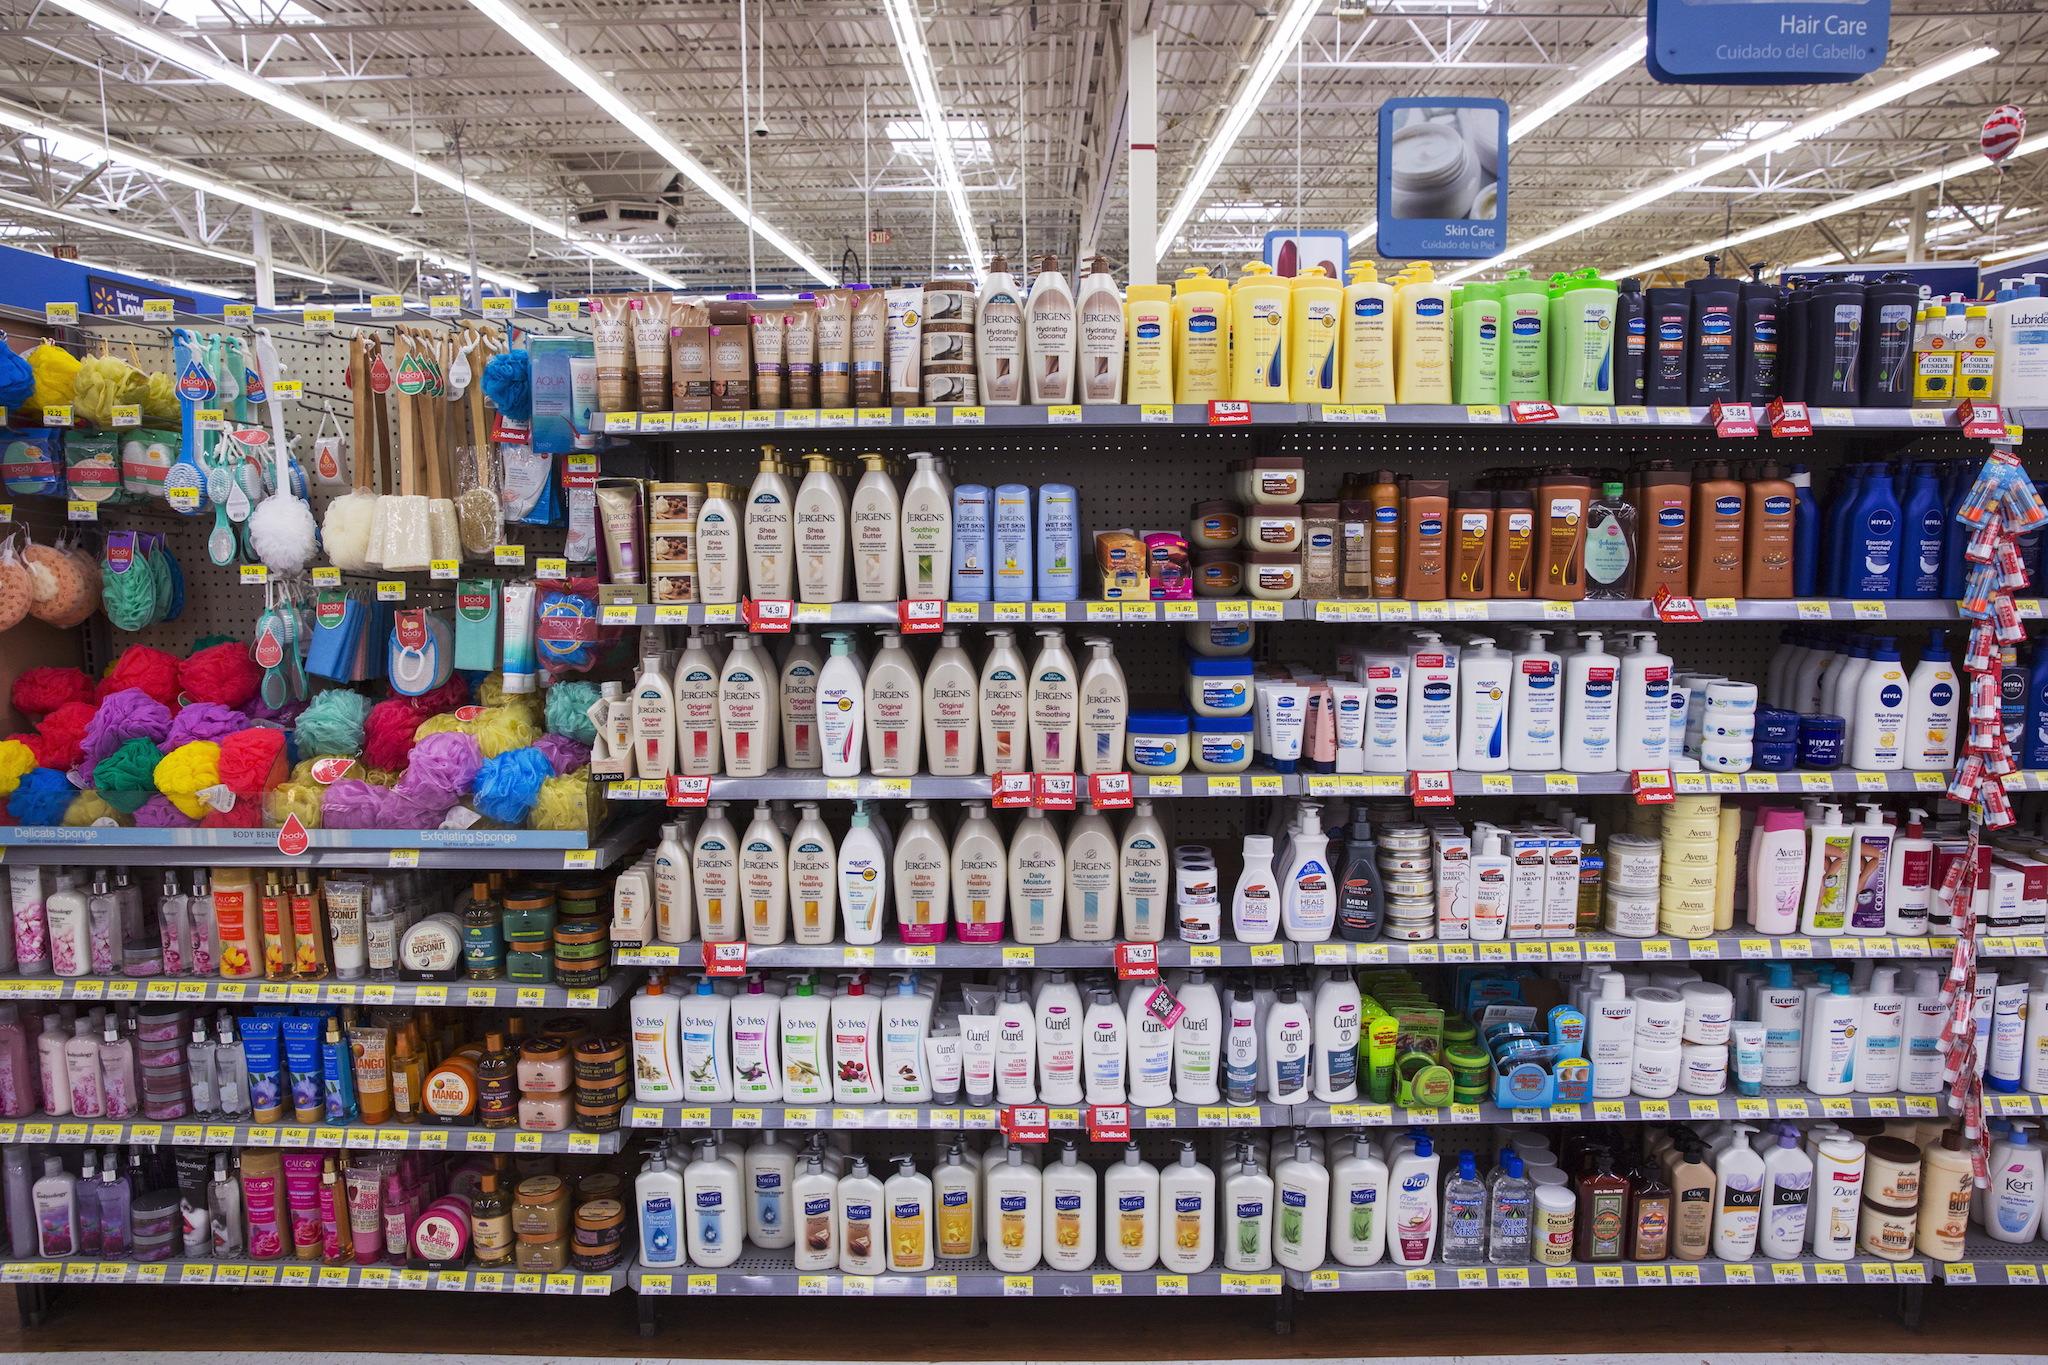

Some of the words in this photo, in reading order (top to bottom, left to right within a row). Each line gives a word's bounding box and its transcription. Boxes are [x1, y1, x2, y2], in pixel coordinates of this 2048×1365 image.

[1781, 15, 1820, 34] Hair
[1825, 15, 1866, 35] Care
[1716, 45, 1782, 60] Cuidado
[1786, 45, 1808, 59] del
[1813, 44, 1865, 60] Cabello
[1445, 225, 1468, 236] Skin
[1471, 225, 1494, 236] Care
[871, 232, 887, 243] EXIT
[1422, 240, 1457, 248] Cuidado
[1460, 241, 1470, 249] de
[1472, 241, 1478, 249] la
[1481, 241, 1495, 249] Piel
[116, 291, 139, 302] Everyday
[1513, 322, 1540, 330] Vaseline
[1703, 320, 1730, 328] Vaseline
[986, 328, 1018, 338] Hydrating
[1036, 326, 1068, 335] Hydrating
[597, 334, 625, 344] GLOW
[638, 333, 666, 342] GLOW
[400, 372, 420, 381] body
[536, 375, 565, 386] AQUA
[182, 378, 206, 386] body
[1221, 403, 1241, 411] $5.84
[1218, 414, 1248, 422] Rollback
[501, 432, 525, 440] Rollback
[80, 469, 102, 478] body
[749, 513, 787, 523] JERGENS
[906, 512, 944, 522] JERGENS
[911, 526, 940, 534] Soothing
[1420, 523, 1442, 531] Vaseline
[111, 548, 130, 557] body
[463, 596, 486, 604] body
[322, 603, 341, 612] body
[766, 606, 784, 614] $4.97
[916, 603, 934, 611] $4.97
[402, 630, 422, 639] body
[260, 646, 278, 654] body
[1424, 688, 1450, 696] Vaseline
[1586, 684, 1612, 692] Vaseline
[1647, 684, 1669, 692] Vaseline
[939, 702, 964, 710] Original
[991, 710, 1016, 718] Defying
[684, 780, 702, 788] $4.97
[1052, 780, 1070, 789] $4.97
[1106, 780, 1124, 788] $4.97
[1425, 780, 1443, 788] $5.84
[14, 828, 55, 838] Delicate
[57, 829, 97, 840] Sponge
[282, 832, 307, 840] body
[420, 831, 473, 842] Exfoliating
[476, 832, 516, 844] Sponge
[1688, 830, 1711, 838] Avena
[1684, 853, 1708, 861] Avena
[1776, 848, 1803, 857] Avena
[1029, 872, 1045, 880] Daily
[703, 878, 726, 886] Healing
[910, 880, 935, 888] Healing
[1680, 901, 1704, 909] Avena
[412, 942, 446, 954] COCONUT
[722, 948, 739, 957] $4.97
[1134, 950, 1152, 958] $4.97
[1152, 991, 1168, 1010] SAVE
[1770, 996, 1800, 1005] Eucerin
[1602, 1007, 1632, 1016] Eucerin
[1874, 1002, 1901, 1012] Eucerin
[1918, 1003, 1946, 1012] Eucerin
[1182, 1016, 1208, 1031] Curél
[1334, 1014, 1358, 1028] Curél
[1648, 1018, 1670, 1026] Eucerin
[241, 1023, 273, 1031] CALGON
[283, 1022, 314, 1031] CALGON
[967, 1030, 989, 1042] Curél
[1001, 1030, 1024, 1042] Curél
[1639, 1064, 1662, 1073] Eucerin
[432, 1090, 463, 1101] MANGO
[1101, 1111, 1118, 1120] $5.47
[176, 1160, 207, 1170] bodycology
[286, 1160, 318, 1168] CALGON
[1403, 1178, 1429, 1188] Dial
[1896, 1183, 1917, 1191] BUTTER
[2006, 1178, 2033, 1193] Keri
[1832, 1186, 1858, 1197] Dove
[1352, 1192, 1376, 1201] Suave
[805, 1201, 829, 1212] Suave
[1002, 1198, 1026, 1208] Suave
[1056, 1198, 1080, 1207] Suave
[1177, 1199, 1200, 1208] Suave
[1238, 1205, 1262, 1215] Suave
[420, 1234, 454, 1248] RASPBERRY
[1882, 1235, 1907, 1243] BUTTER
